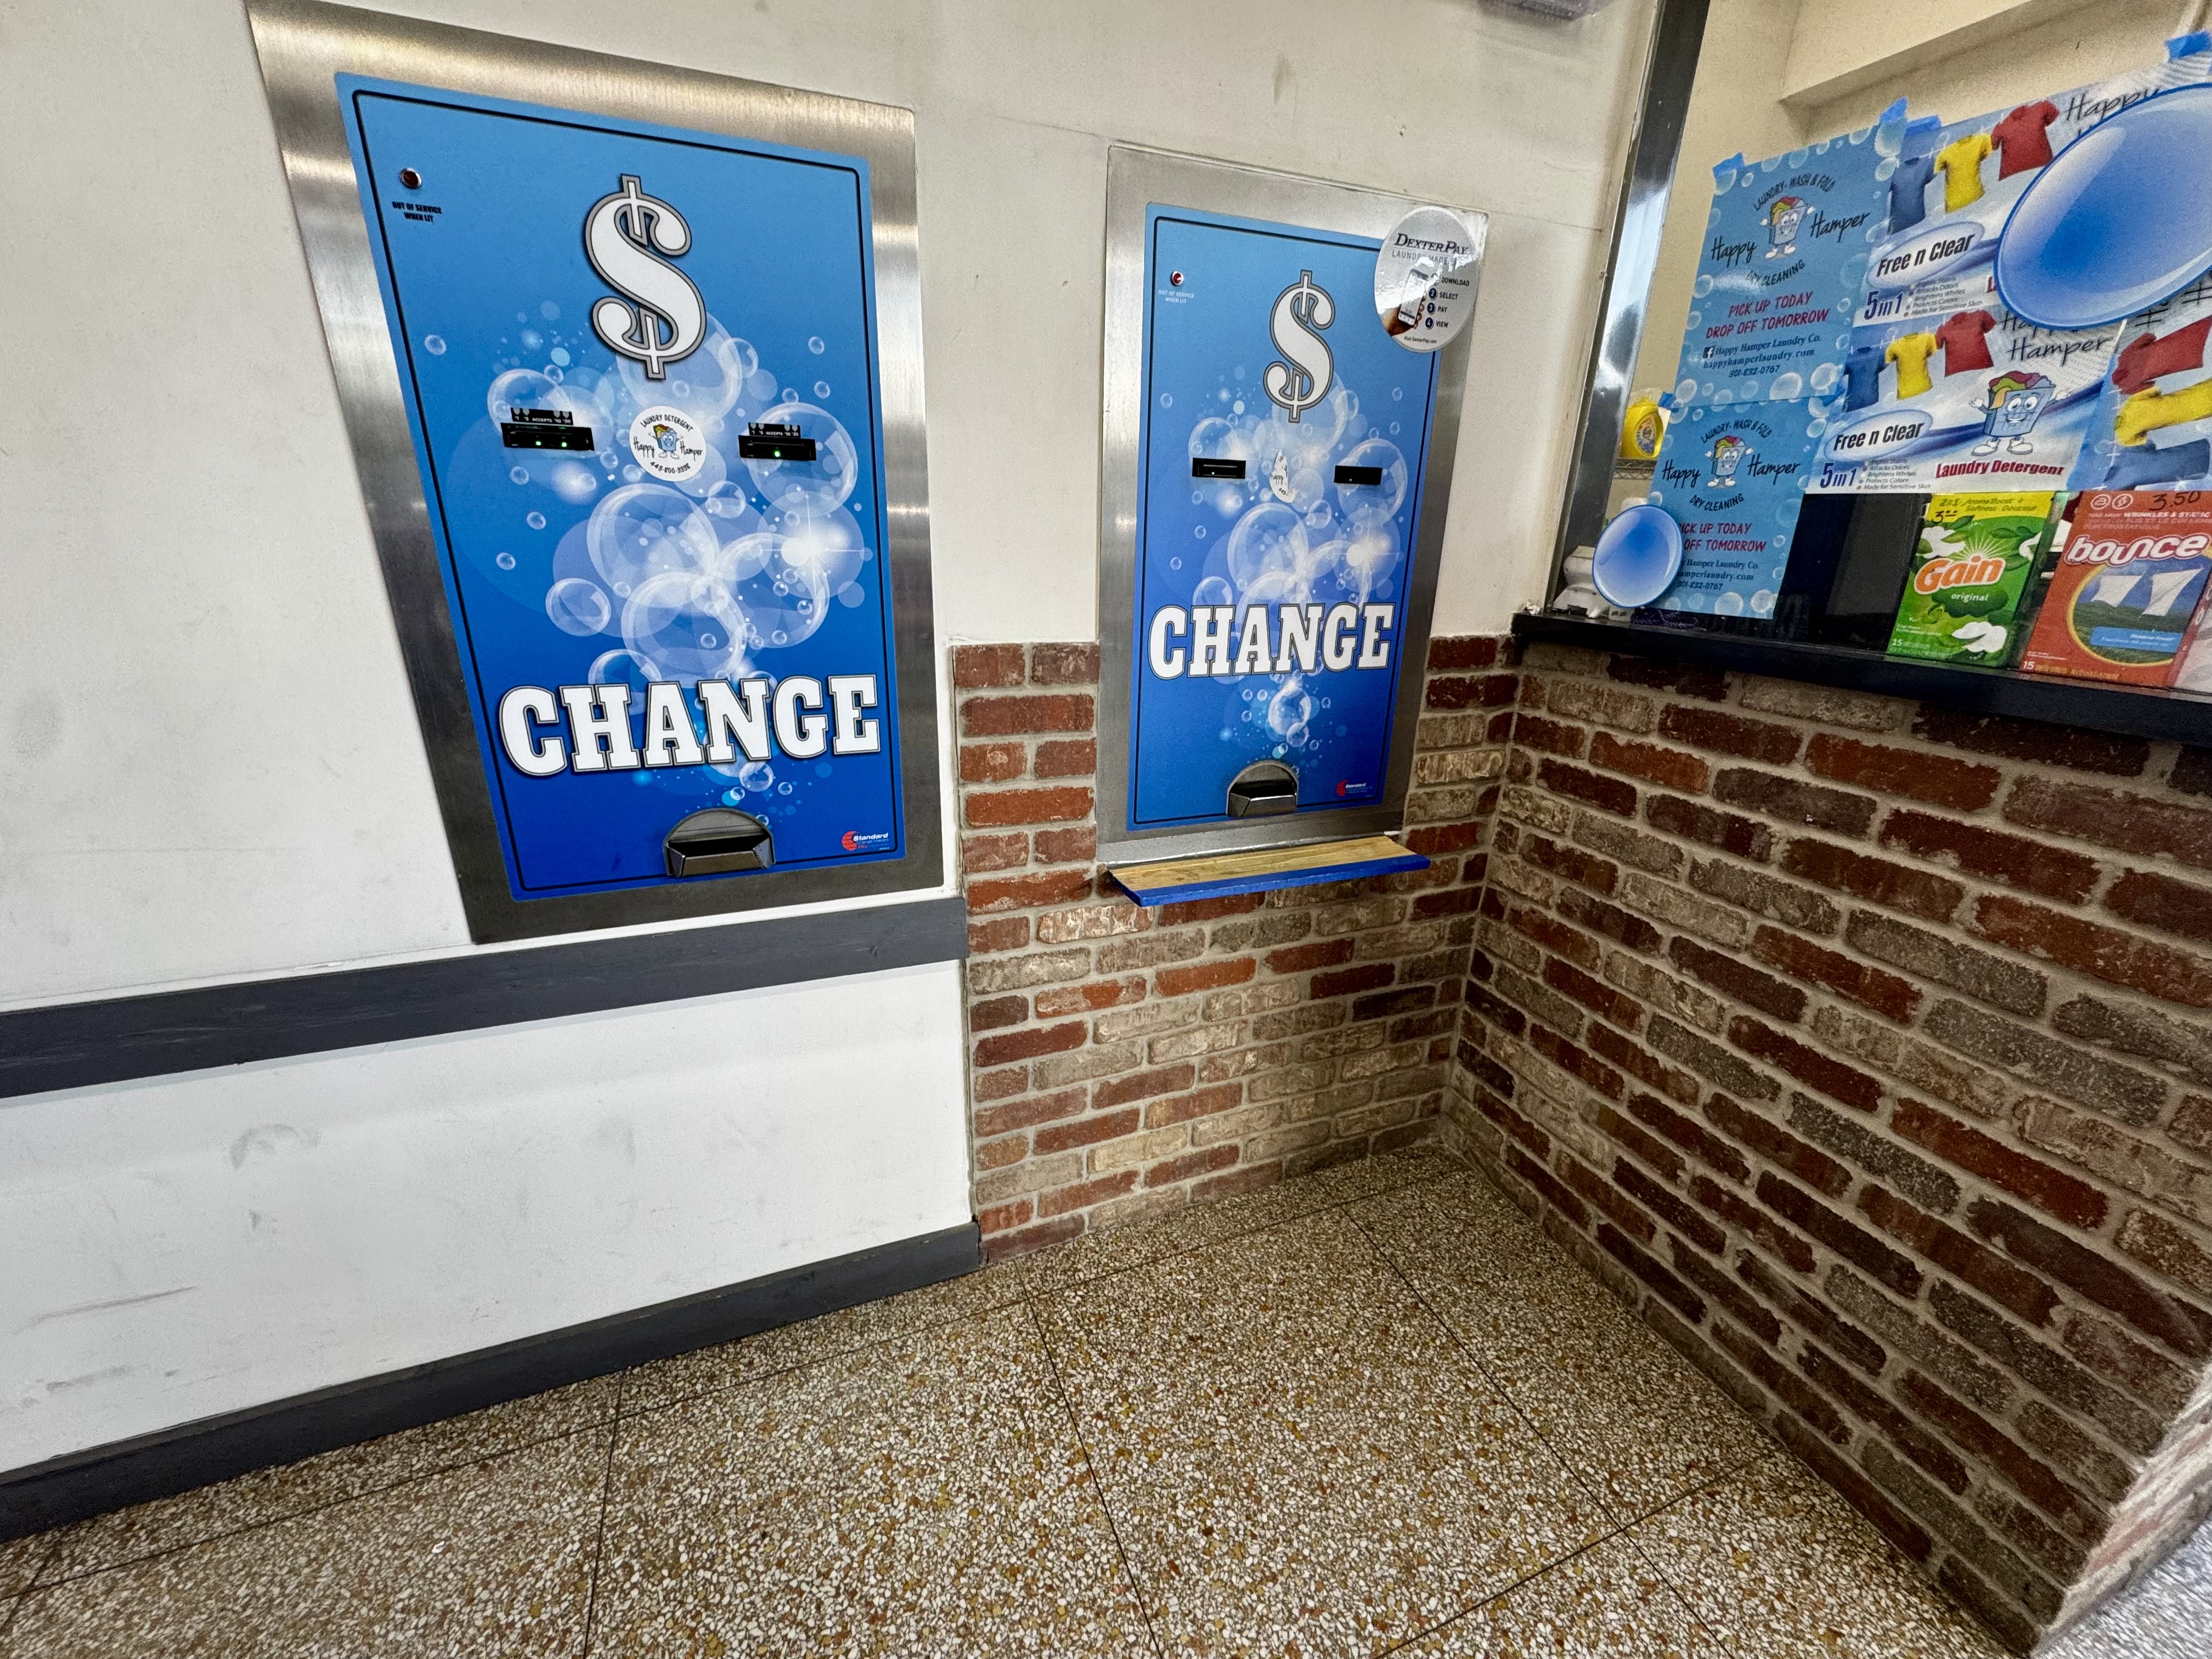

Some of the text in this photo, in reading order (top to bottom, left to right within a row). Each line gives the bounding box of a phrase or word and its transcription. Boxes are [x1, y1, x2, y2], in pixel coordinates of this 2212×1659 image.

[1790, 173, 1812, 189] WASH
[1816, 174, 1836, 193] FOLD
[404, 212, 423, 221] WHEN
[415, 204, 442, 214] SERVICE
[1711, 211, 1870, 268] Happy Hamper
[1392, 249, 1425, 261] LAUNDR
[1876, 234, 1975, 277] Free n Clear
[1442, 276, 1470, 286] DOWNLOAD
[1761, 259, 1805, 286] CLEANING
[1440, 291, 1458, 300] SELECT
[1728, 291, 1813, 318] PICK UP TODAY
[1706, 308, 1830, 339] DROP OFF TOMORROW
[1716, 346, 1738, 356] Happy
[1740, 342, 1771, 353] Hamper
[1772, 335, 1806, 348] Laundry
[2007, 337, 2113, 366] Hamper
[1703, 348, 1814, 369] happyhamperlaundry.com
[1729, 364, 1780, 377] 301-832-0767
[640, 414, 693, 432] LAUNDRY DETERGENT
[1734, 419, 1753, 429] WASH
[1756, 423, 1772, 438] FOLD
[1833, 422, 1925, 451] Free n Clear
[633, 436, 703, 461] Happy Hamper
[1662, 454, 1801, 489] Happy Hamper
[1935, 460, 2064, 479] Laundry Detergent
[1690, 493, 1744, 511] DRY CLEANING
[2148, 491, 2201, 511] 3.50
[1700, 523, 1713, 534] UP
[1717, 522, 1752, 535] TODAY
[1684, 539, 1767, 553] OFF TOMORROW
[2066, 535, 2209, 566] bounce
[1686, 559, 1714, 568] Hamper
[1716, 560, 1746, 570] Laundry
[1678, 571, 1754, 582] amperlaundry.com
[1915, 555, 2005, 594] Gain
[1677, 581, 1724, 590] 301-832-0767
[1951, 593, 1989, 603] original
[1149, 602, 1396, 680] CHANGE
[2023, 661, 2035, 670] 15
[499, 674, 882, 776] CHANGE
[853, 832, 888, 842] Standard
